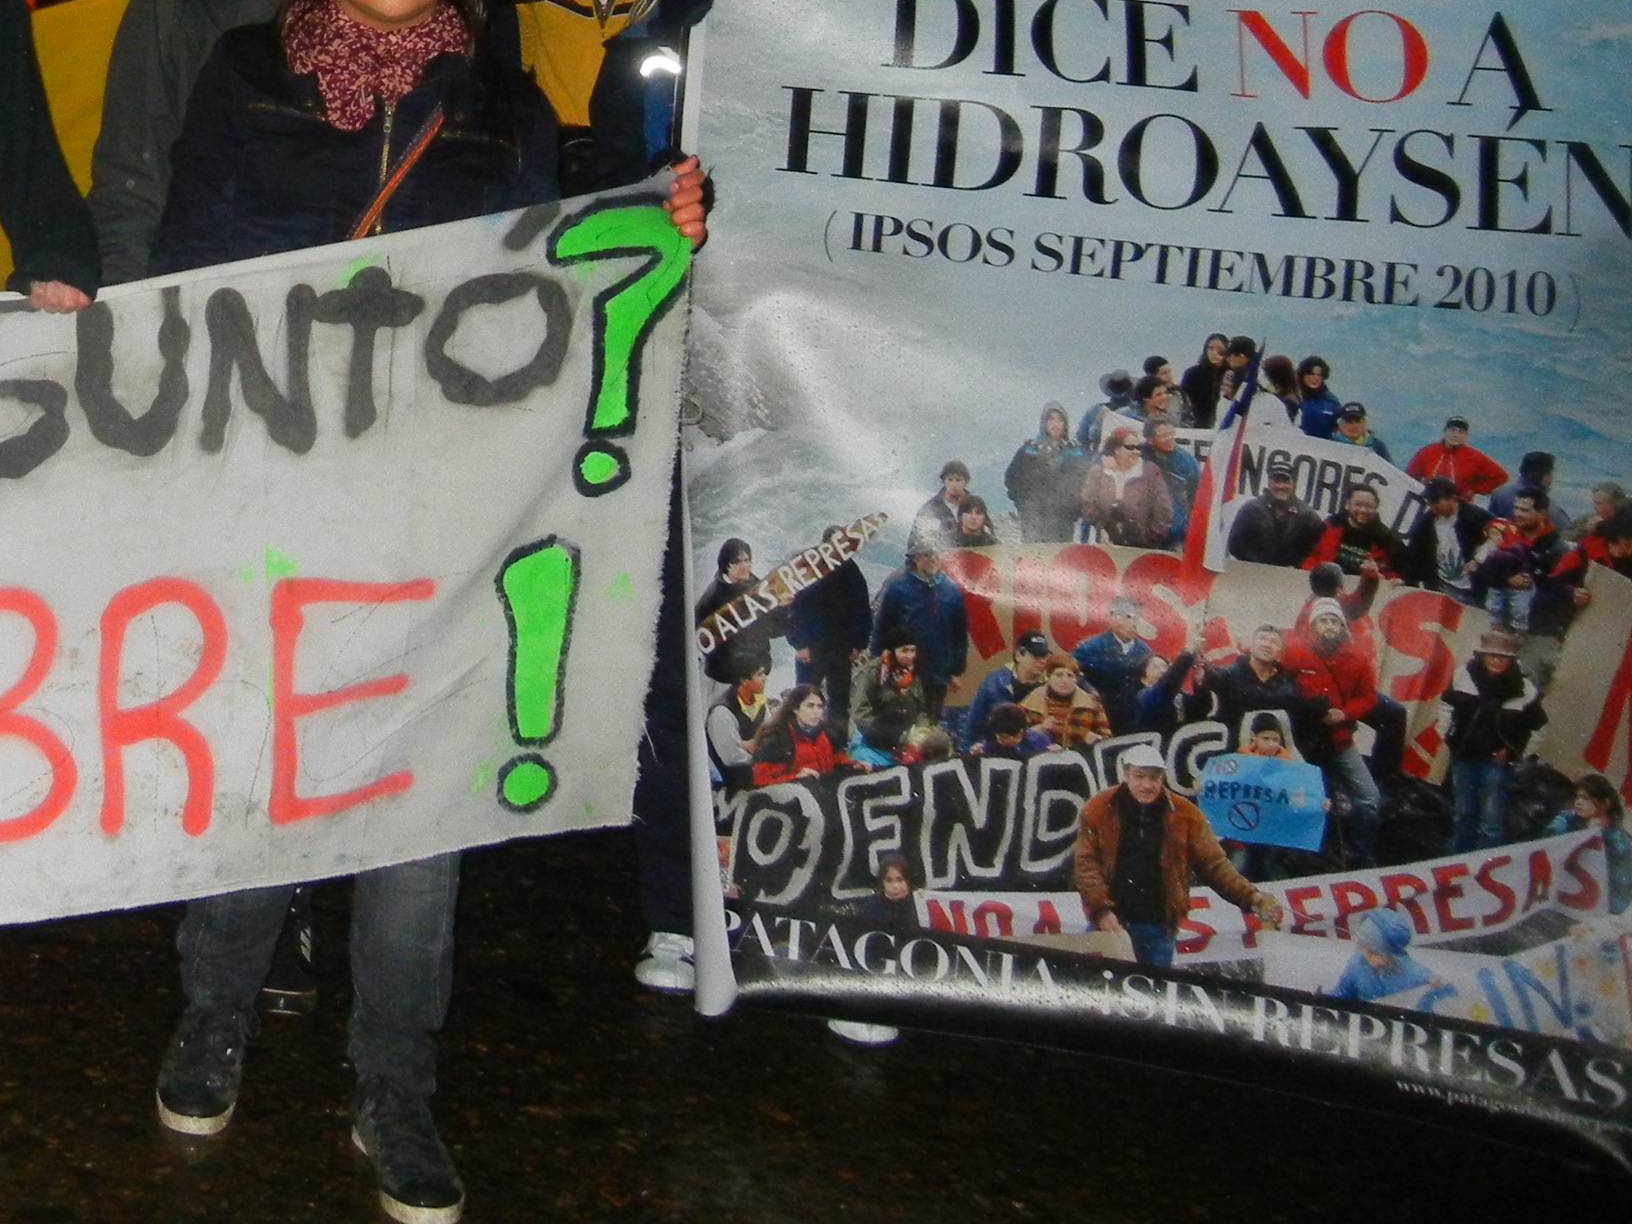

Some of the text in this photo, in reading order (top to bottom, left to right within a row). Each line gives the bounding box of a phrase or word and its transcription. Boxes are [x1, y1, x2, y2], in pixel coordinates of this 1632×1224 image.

[1228, 9, 1428, 104] NO
[1446, 11, 1553, 113] A
[775, 85, 1632, 240] HIDROAYSÉN
[1030, 231, 1421, 308] SEPTIEMBRE
[1249, 994, 1628, 1109] REPRESAS
